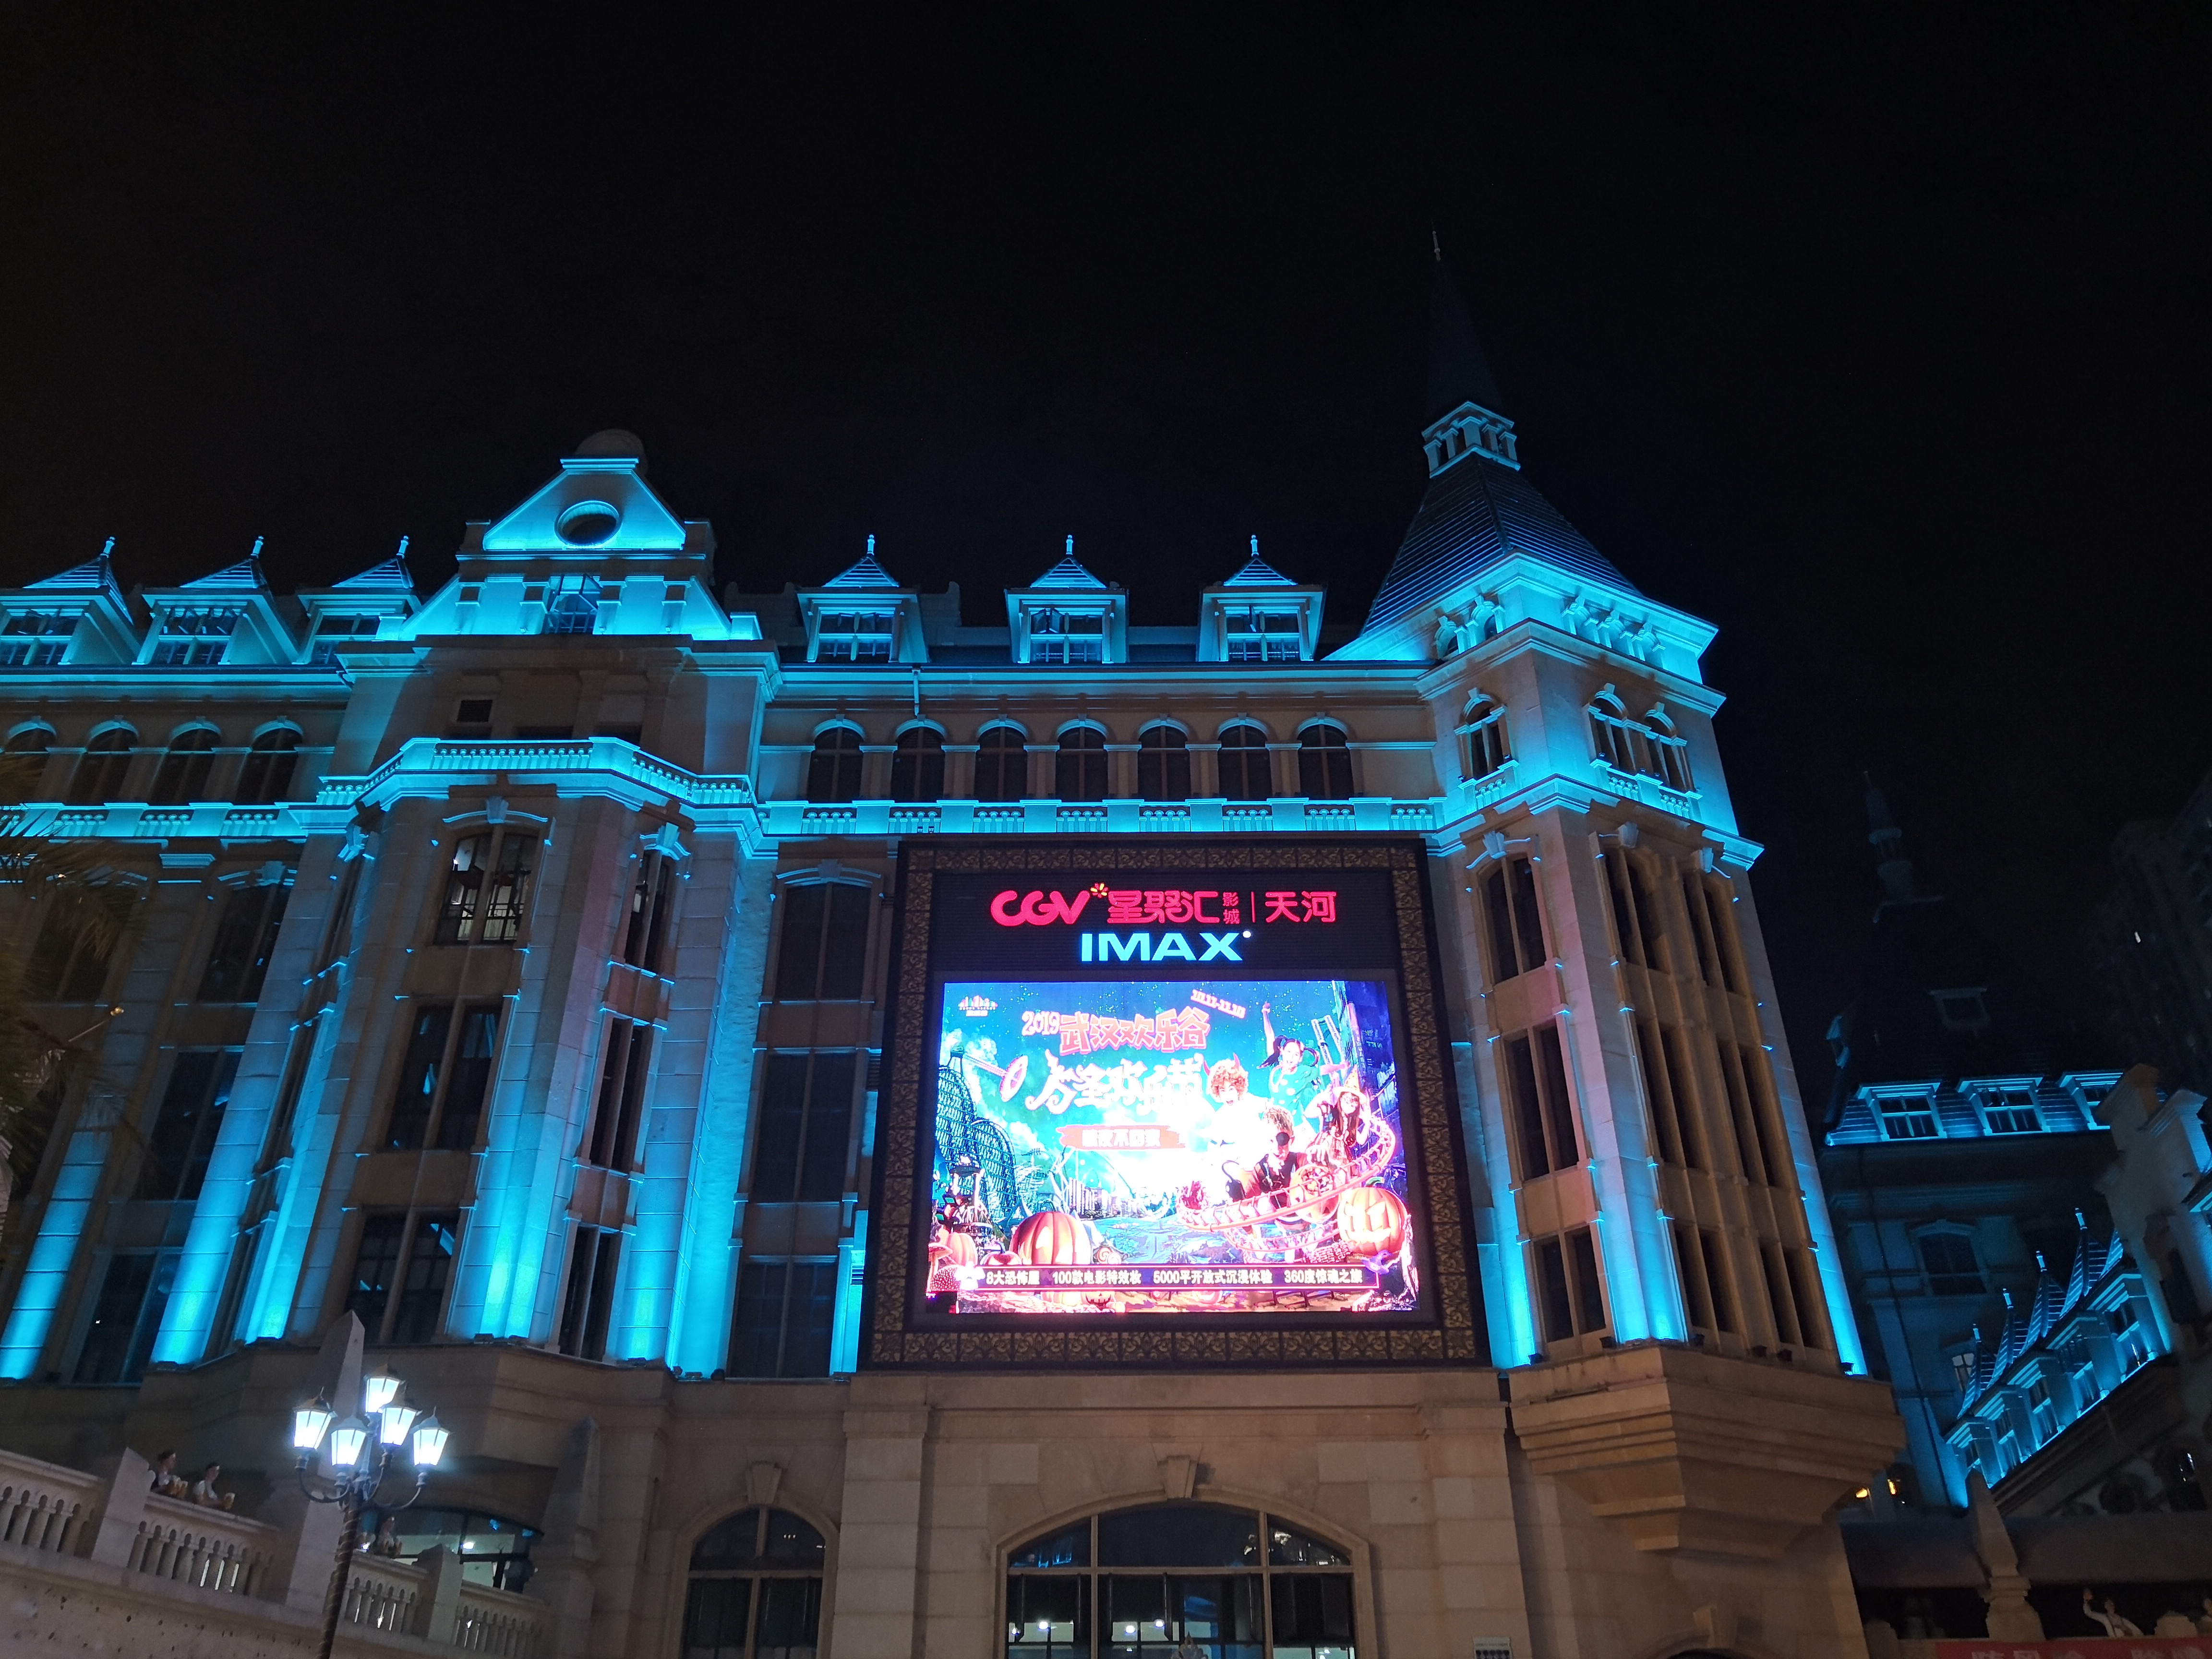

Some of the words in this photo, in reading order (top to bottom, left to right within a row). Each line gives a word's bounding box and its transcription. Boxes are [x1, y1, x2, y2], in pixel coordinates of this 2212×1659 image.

[991, 890, 1091, 926] CGV
[1222, 891, 1240, 925] 影城
[1265, 891, 1336, 923] 天河
[1081, 932, 1243, 962] IMAX
[986, 1270, 1040, 1285] 8大恐怖屋
[1053, 1270, 1141, 1285] 100款电影特效妆
[1153, 1270, 1273, 1284] 5000平开放式沉浸体验
